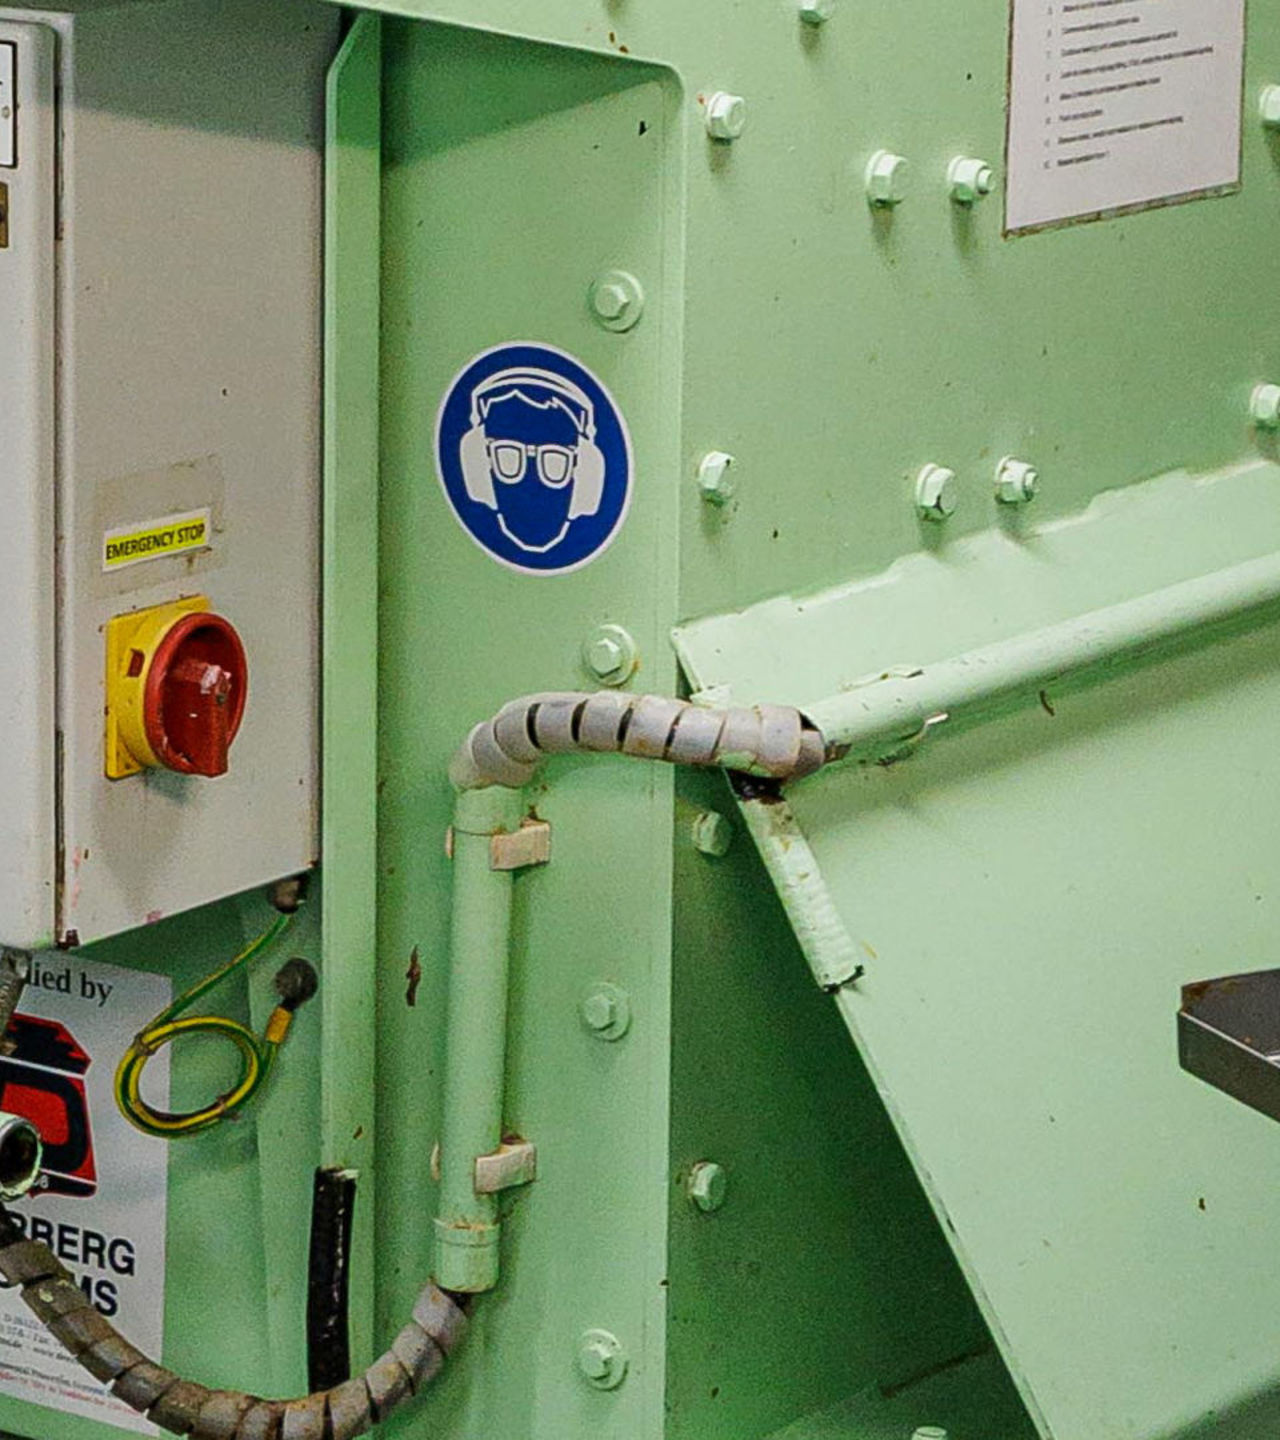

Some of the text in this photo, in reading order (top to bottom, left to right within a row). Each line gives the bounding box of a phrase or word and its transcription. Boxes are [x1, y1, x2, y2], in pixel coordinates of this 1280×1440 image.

[106, 522, 206, 561] EMERGENCY STOP
[80, 971, 114, 1008] by
